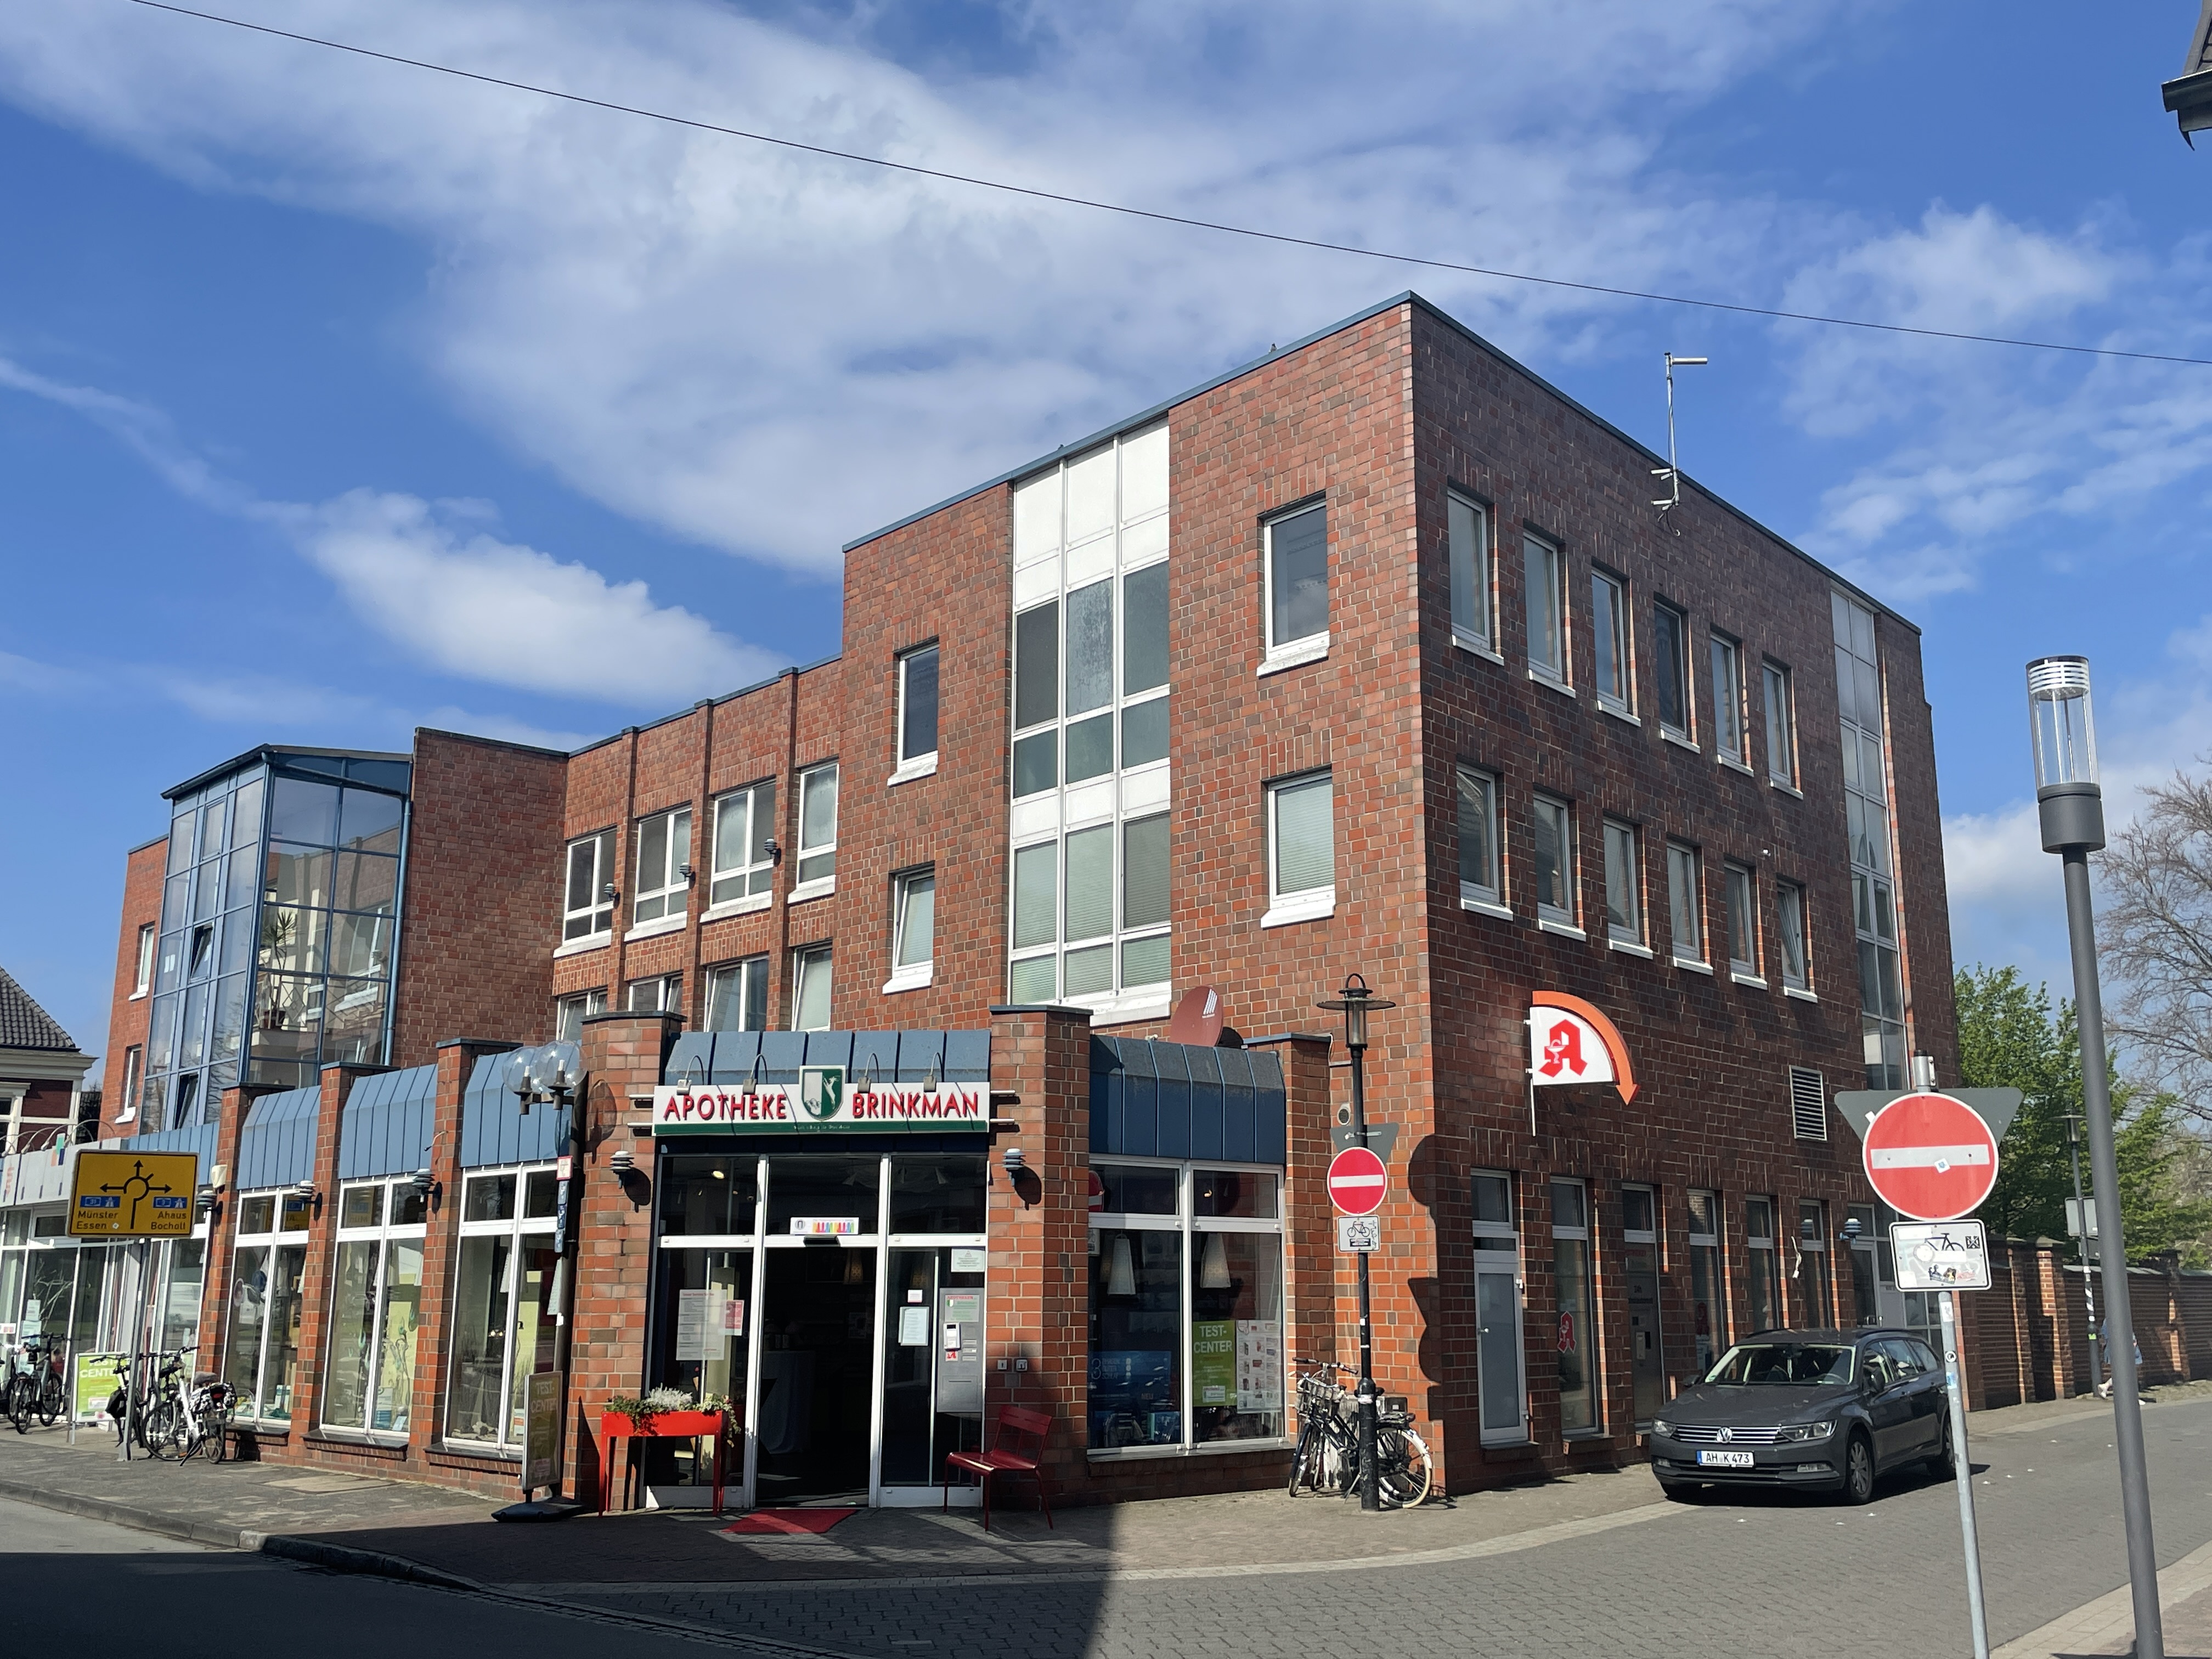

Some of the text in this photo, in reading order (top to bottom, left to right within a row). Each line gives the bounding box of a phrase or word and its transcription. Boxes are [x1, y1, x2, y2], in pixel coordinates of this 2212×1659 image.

[663, 1092, 978, 1121] APOTHEKE BRINKMAN
[78, 1210, 119, 1219] Münster
[77, 1221, 107, 1229] Essen
[151, 1222, 185, 1230] Bocholt
[1199, 1324, 1227, 1338] TEST-
[1193, 1340, 1233, 1353] CENTER
[535, 1381, 555, 1395] TEST-
[1706, 1453, 1750, 1463] AH K 473
